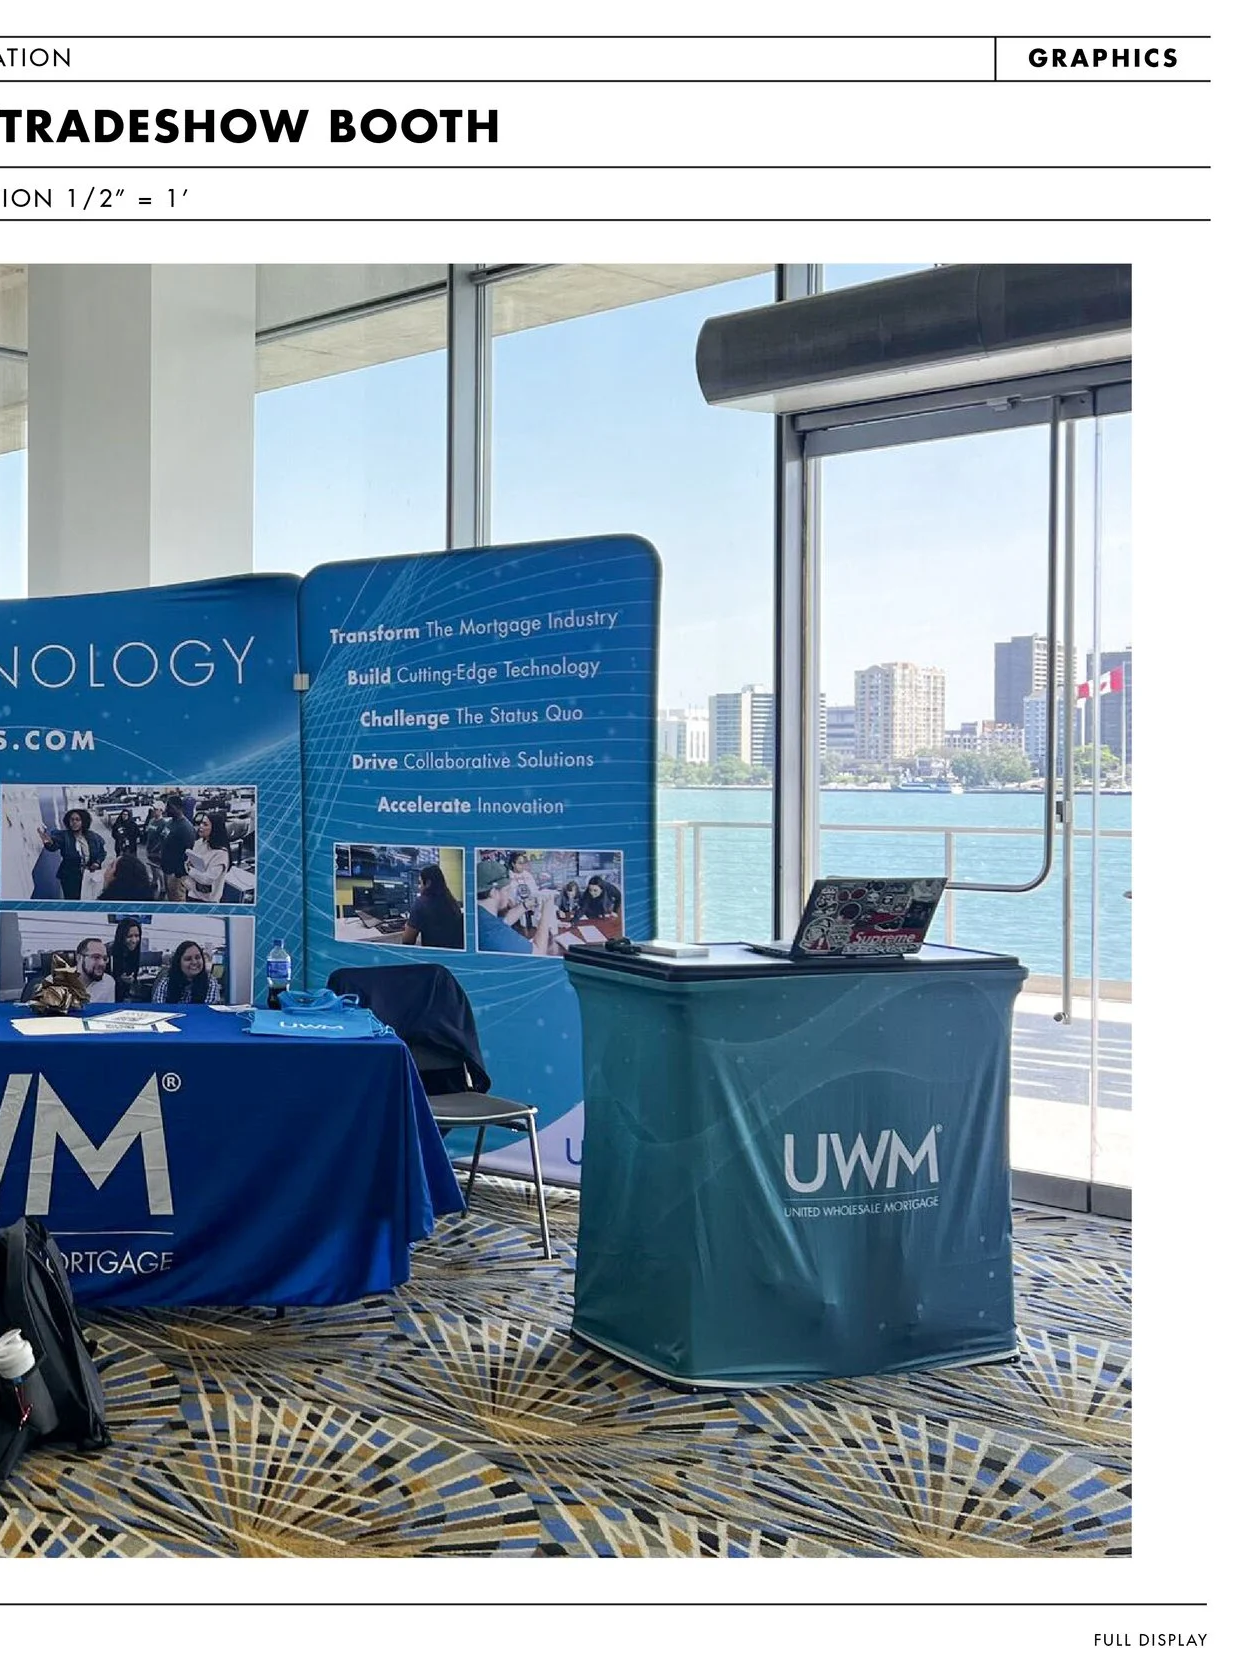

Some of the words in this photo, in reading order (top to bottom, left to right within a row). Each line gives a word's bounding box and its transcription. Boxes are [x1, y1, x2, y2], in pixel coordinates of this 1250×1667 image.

[330, 624, 420, 644] Transform
[426, 619, 454, 637] The
[459, 616, 542, 640] Mortgage
[547, 609, 619, 631] Industry
[348, 666, 391, 685] Build
[396, 661, 498, 685] Cutting-Edge
[503, 656, 601, 680] Technology
[360, 709, 450, 730] Challenge
[455, 706, 484, 724] The
[489, 706, 539, 724] Status
[545, 704, 584, 724] Quo
[352, 753, 399, 770] Drive
[403, 751, 511, 770] Collaborative
[517, 751, 595, 769] Solutions
[377, 795, 472, 814] Accelerate
[478, 796, 565, 815] Innovation
[853, 931, 916, 944] Supreme
[279, 1020, 344, 1030] UWM
[784, 1206, 821, 1218] UNITED
[823, 1202, 881, 1217] WHOLESALE
[884, 1195, 940, 1213] MORTGAGE
[45, 1250, 174, 1275] ORTGAGE
